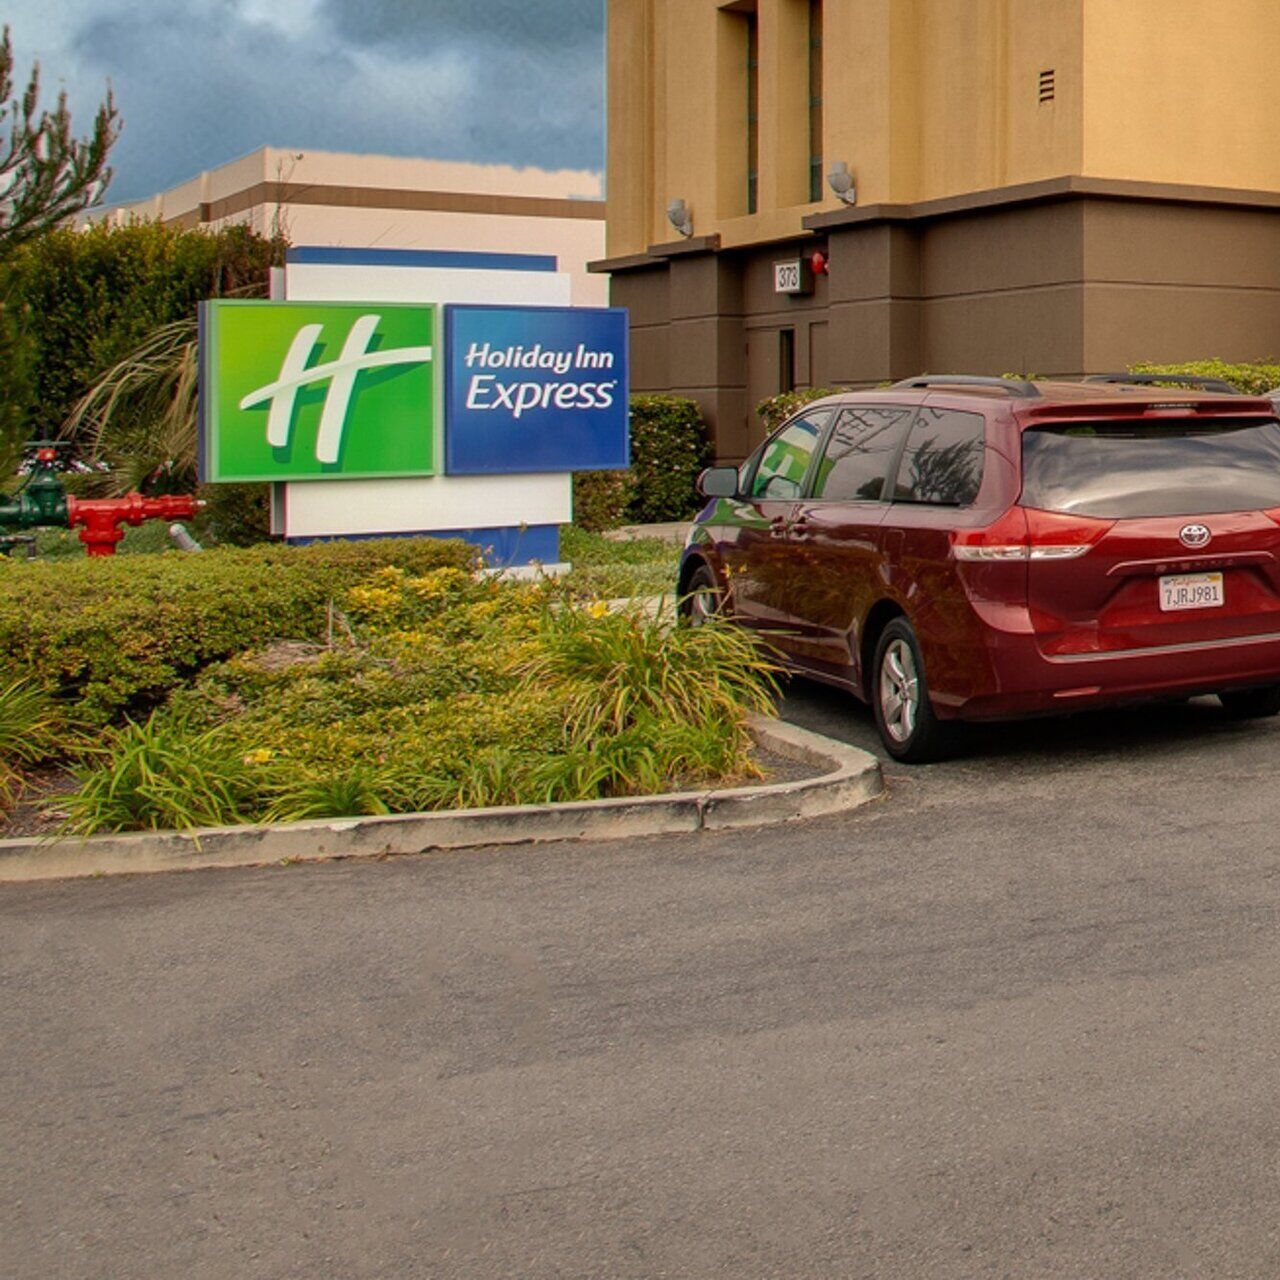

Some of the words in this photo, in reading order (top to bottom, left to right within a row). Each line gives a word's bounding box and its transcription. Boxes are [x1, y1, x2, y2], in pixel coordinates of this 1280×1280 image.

[779, 265, 798, 288] 373
[465, 342, 573, 374] Holiday
[575, 344, 615, 369] Inn
[465, 374, 615, 418] Express
[1165, 585, 1220, 606] 7JRJ981
